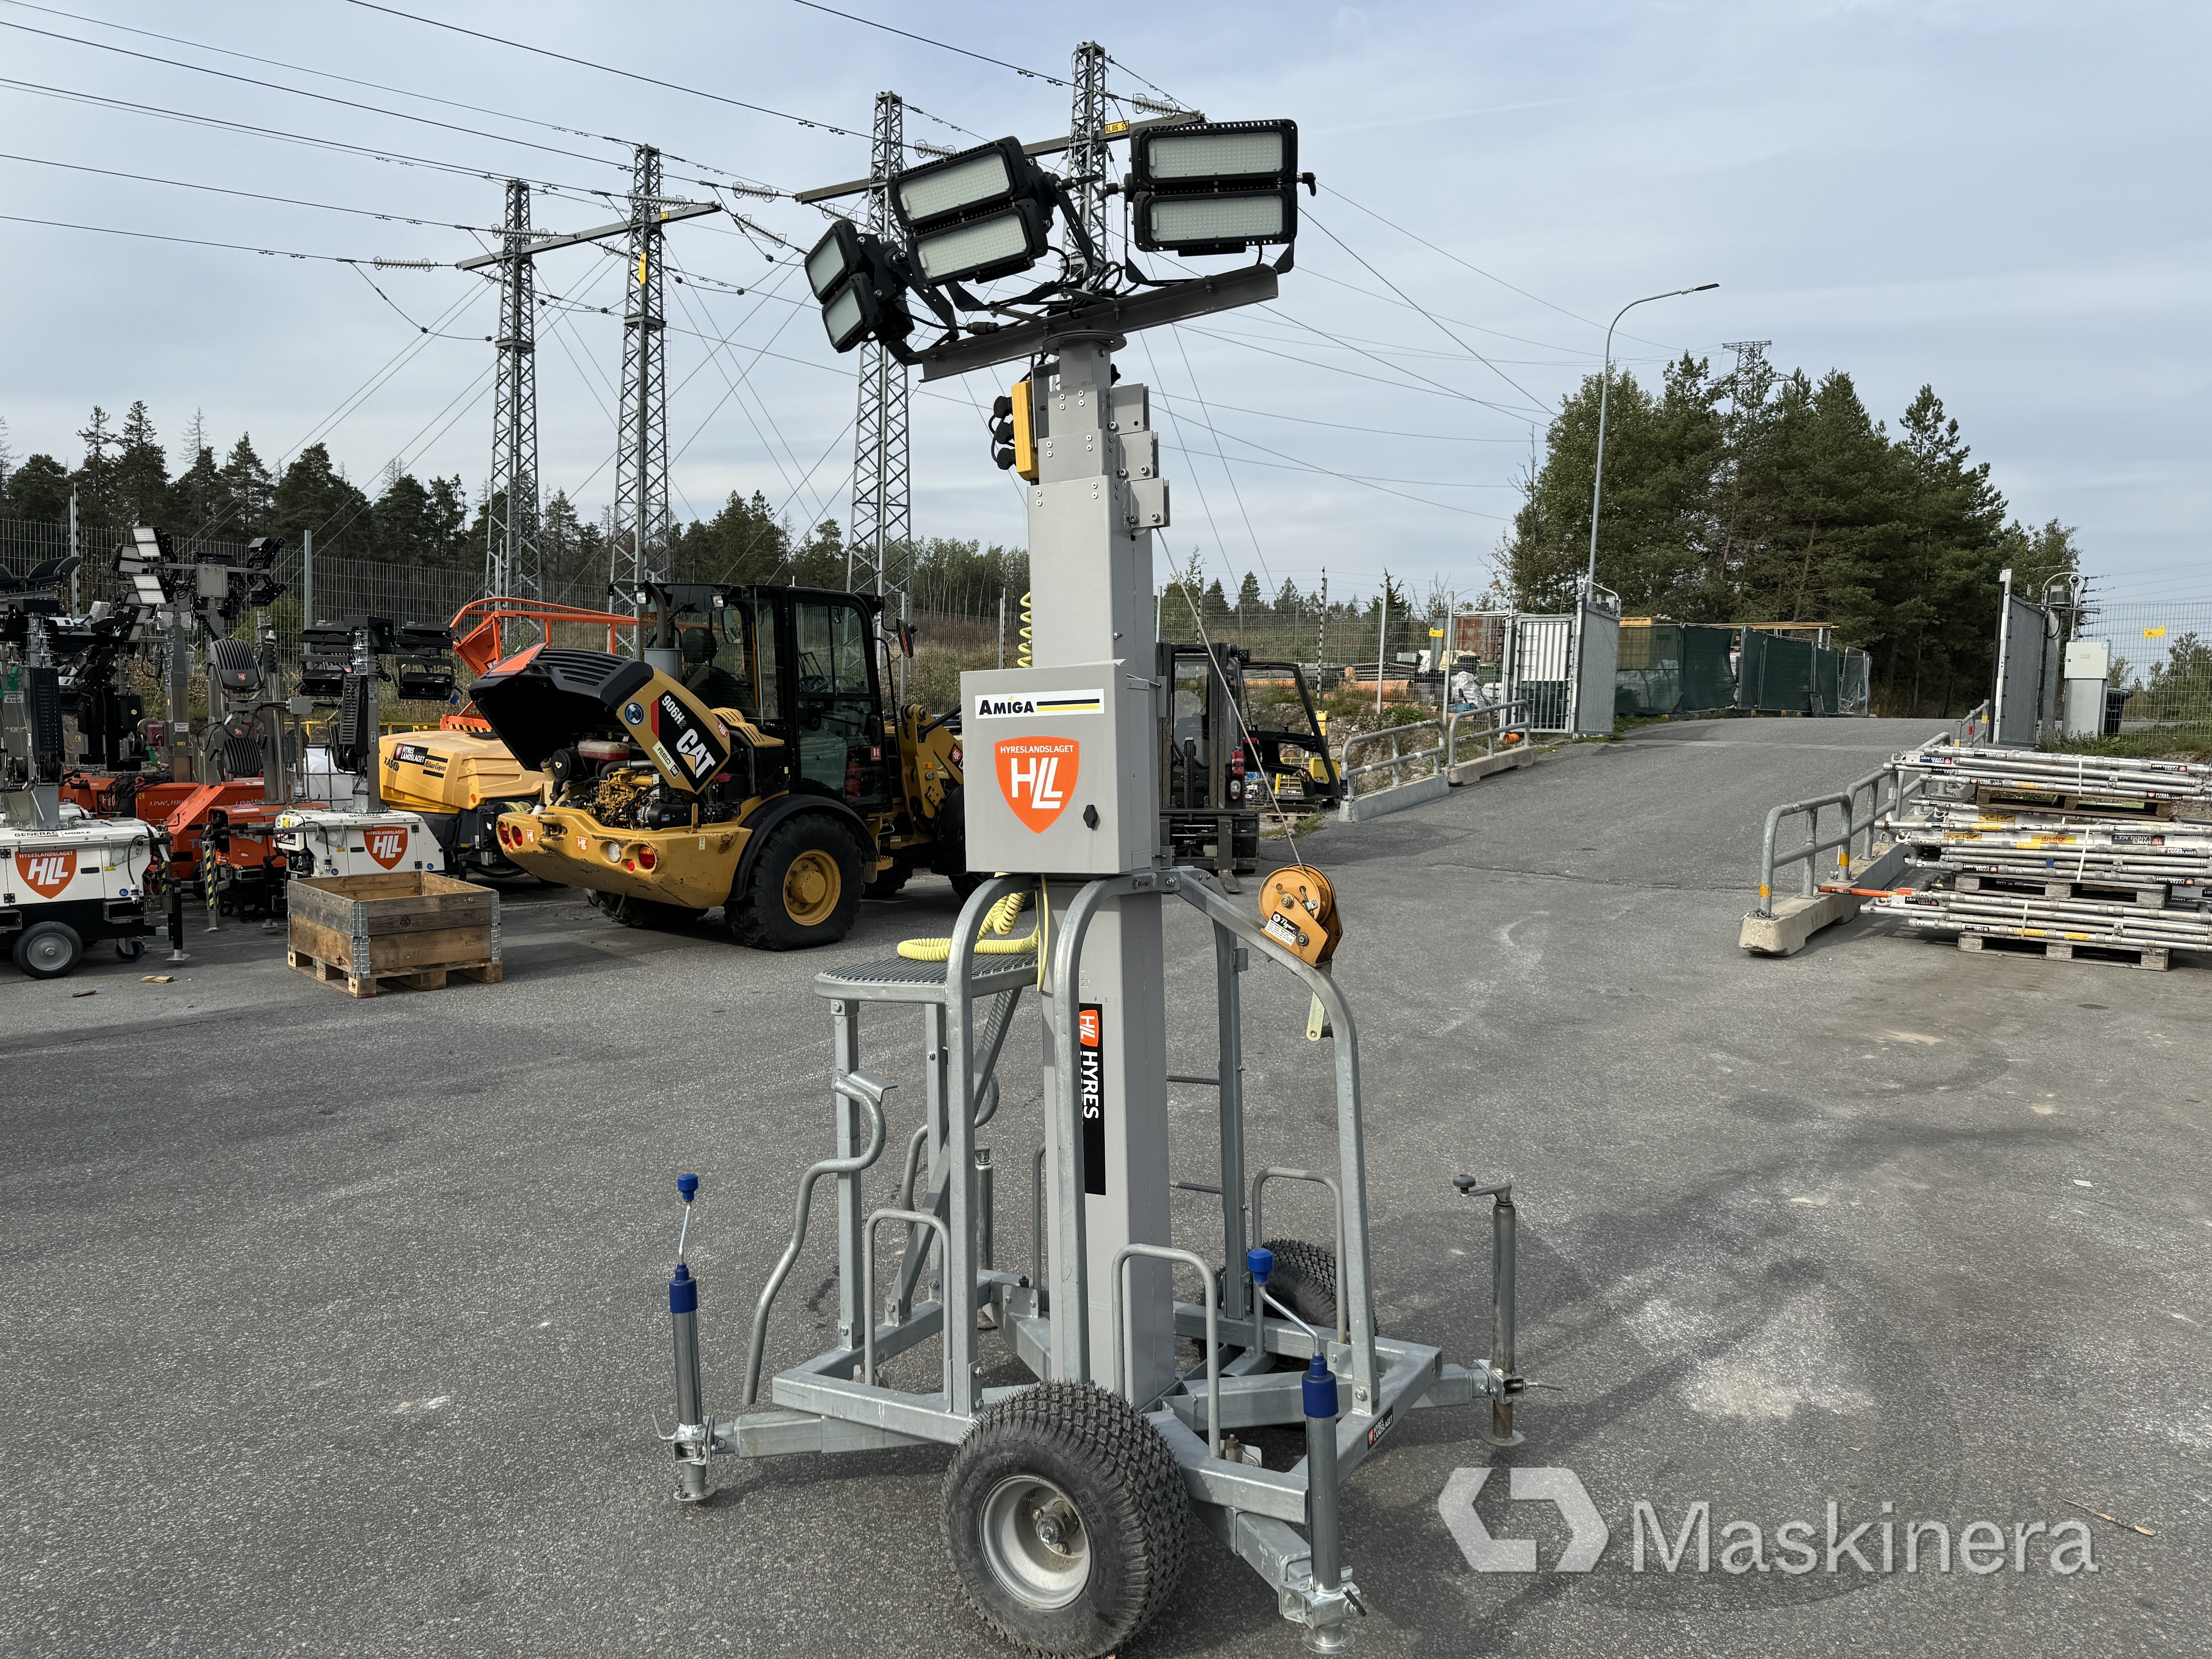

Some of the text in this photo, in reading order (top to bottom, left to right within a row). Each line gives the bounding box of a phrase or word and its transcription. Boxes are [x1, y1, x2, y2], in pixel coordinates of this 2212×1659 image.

[1106, 124, 1118, 132] AL86
[979, 696, 1034, 715] AMIGA
[401, 753, 425, 763] LANDSLAGET
[677, 728, 716, 779] CAT
[1000, 744, 1074, 754] HYRESLANDSLAGET
[435, 763, 446, 771] Copco
[1011, 757, 1063, 809] HLL
[373, 835, 402, 859] HLL
[27, 857, 69, 886] HLL
[1083, 1051, 1099, 1119] HYRES
